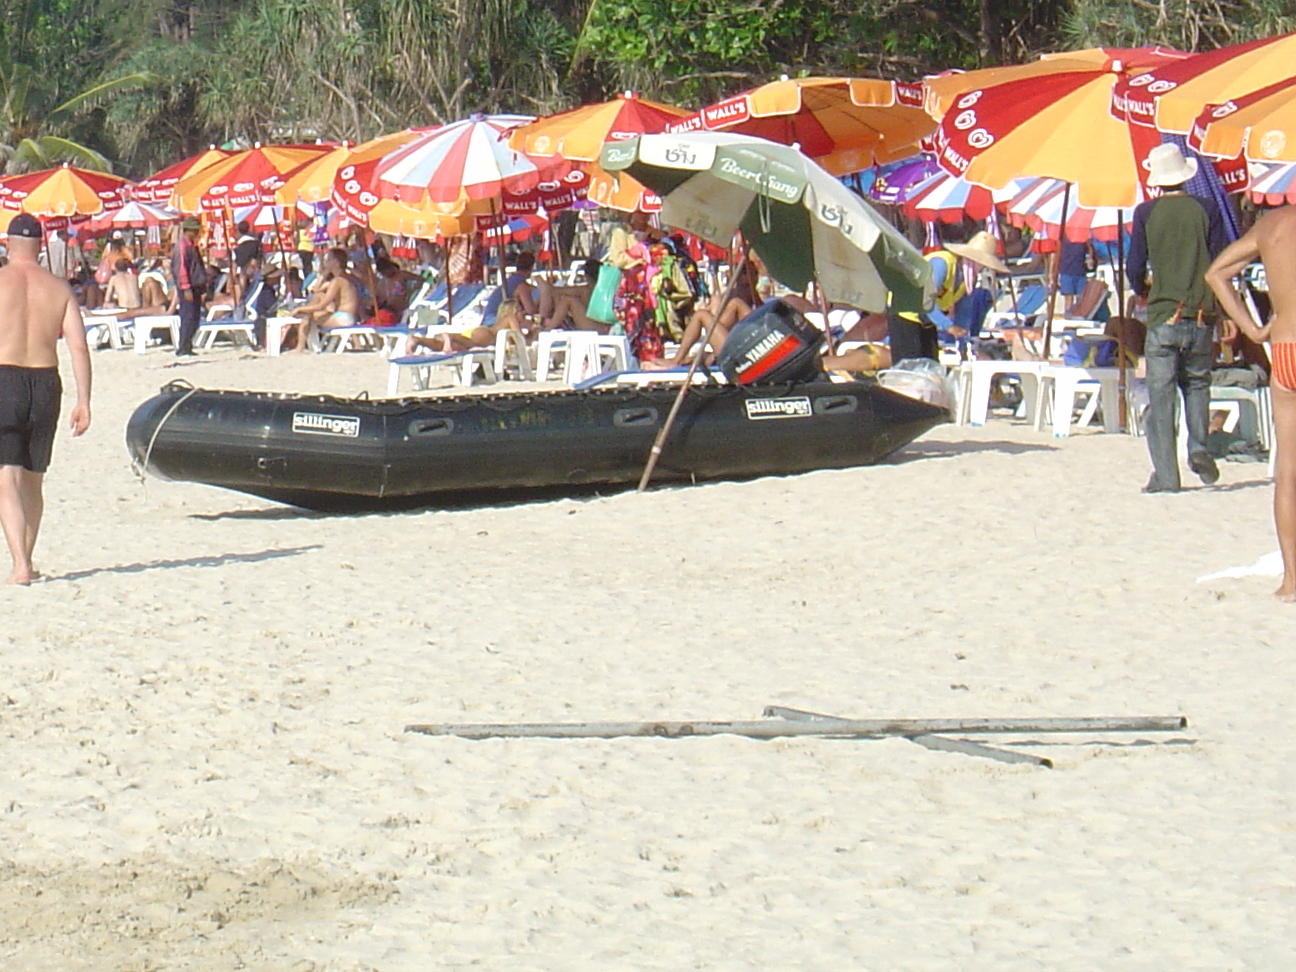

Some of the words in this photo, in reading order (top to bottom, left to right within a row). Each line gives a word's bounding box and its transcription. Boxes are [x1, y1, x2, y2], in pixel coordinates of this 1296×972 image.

[707, 101, 746, 121] WALL'S
[1128, 96, 1154, 116] WALL'S
[944, 145, 969, 172] WALL'S
[505, 201, 537, 211] WALL'S
[544, 193, 571, 207] WALL'S
[745, 329, 785, 363] YAMAHA
[747, 399, 808, 414] sillinger
[294, 414, 357, 433] sillinger
